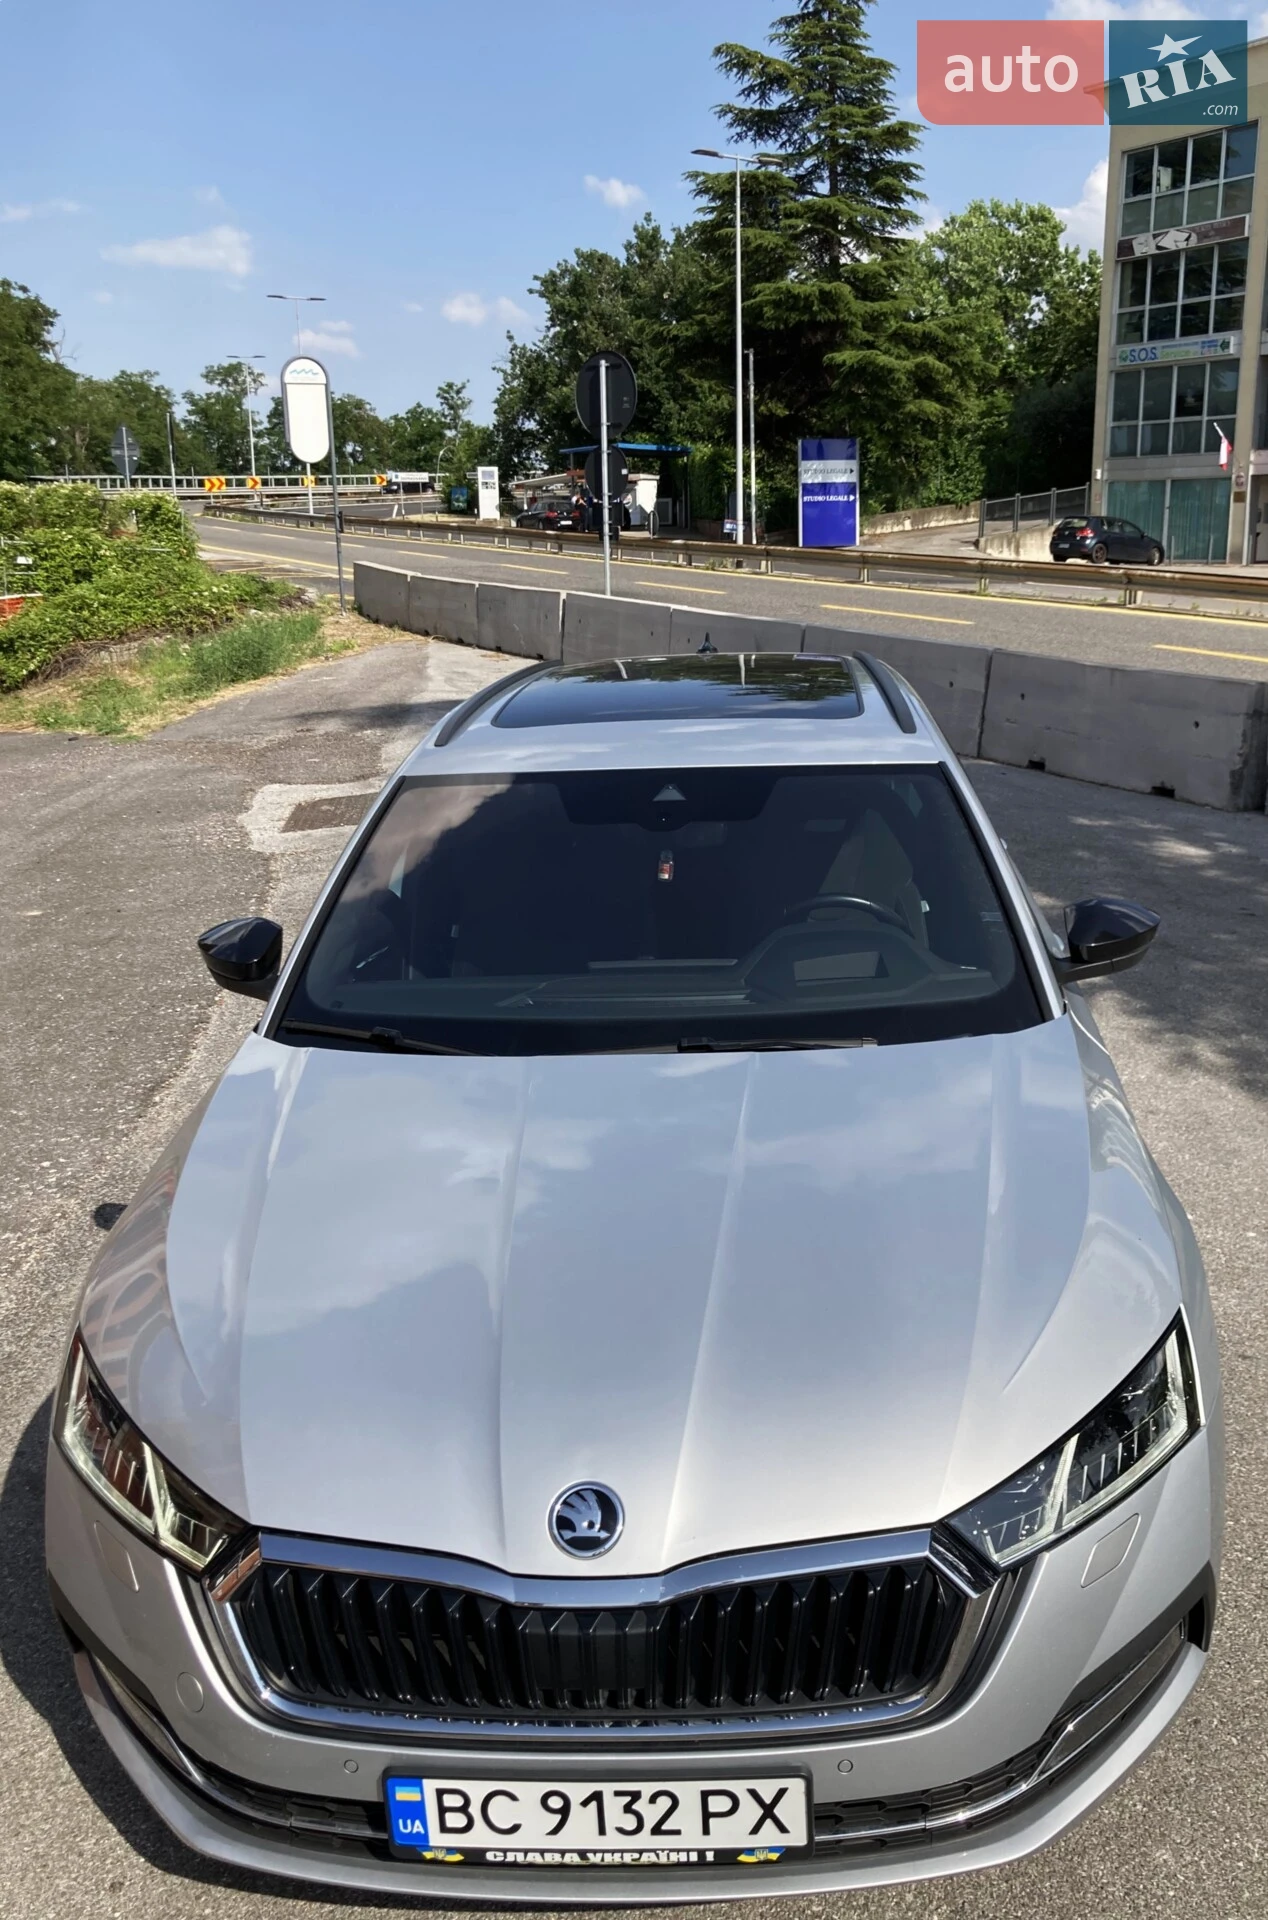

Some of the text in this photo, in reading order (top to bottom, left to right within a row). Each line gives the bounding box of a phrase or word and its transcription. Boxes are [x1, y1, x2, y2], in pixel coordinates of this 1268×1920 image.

[435, 1787, 791, 1836] BC 9132 PX
[398, 1818, 425, 1835] UA
[485, 1850, 581, 1863] СЛАВА
